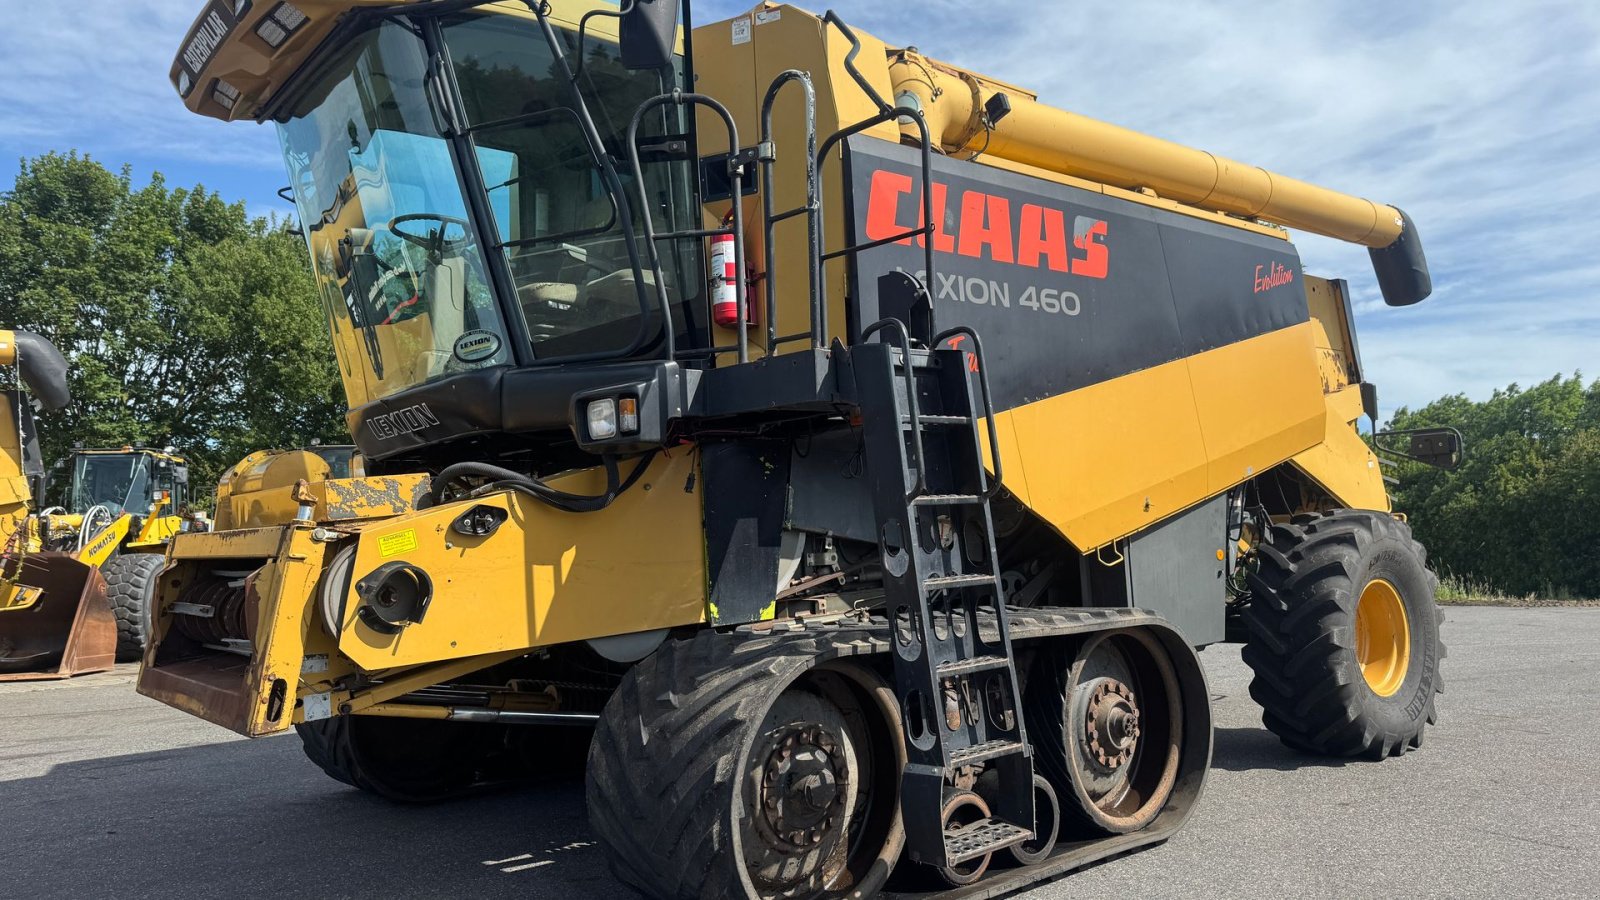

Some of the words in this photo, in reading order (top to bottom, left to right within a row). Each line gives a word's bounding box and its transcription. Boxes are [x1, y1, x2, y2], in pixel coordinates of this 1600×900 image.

[183, 10, 228, 74] CATERPILLAR
[866, 169, 1108, 279] CLAAS
[896, 266, 1009, 308] XION
[1019, 285, 1081, 316] 460
[1253, 260, 1293, 293] Evolution
[460, 337, 491, 350] LEXION
[366, 402, 440, 440] LEXION
[88, 530, 116, 558] KOMATSU
